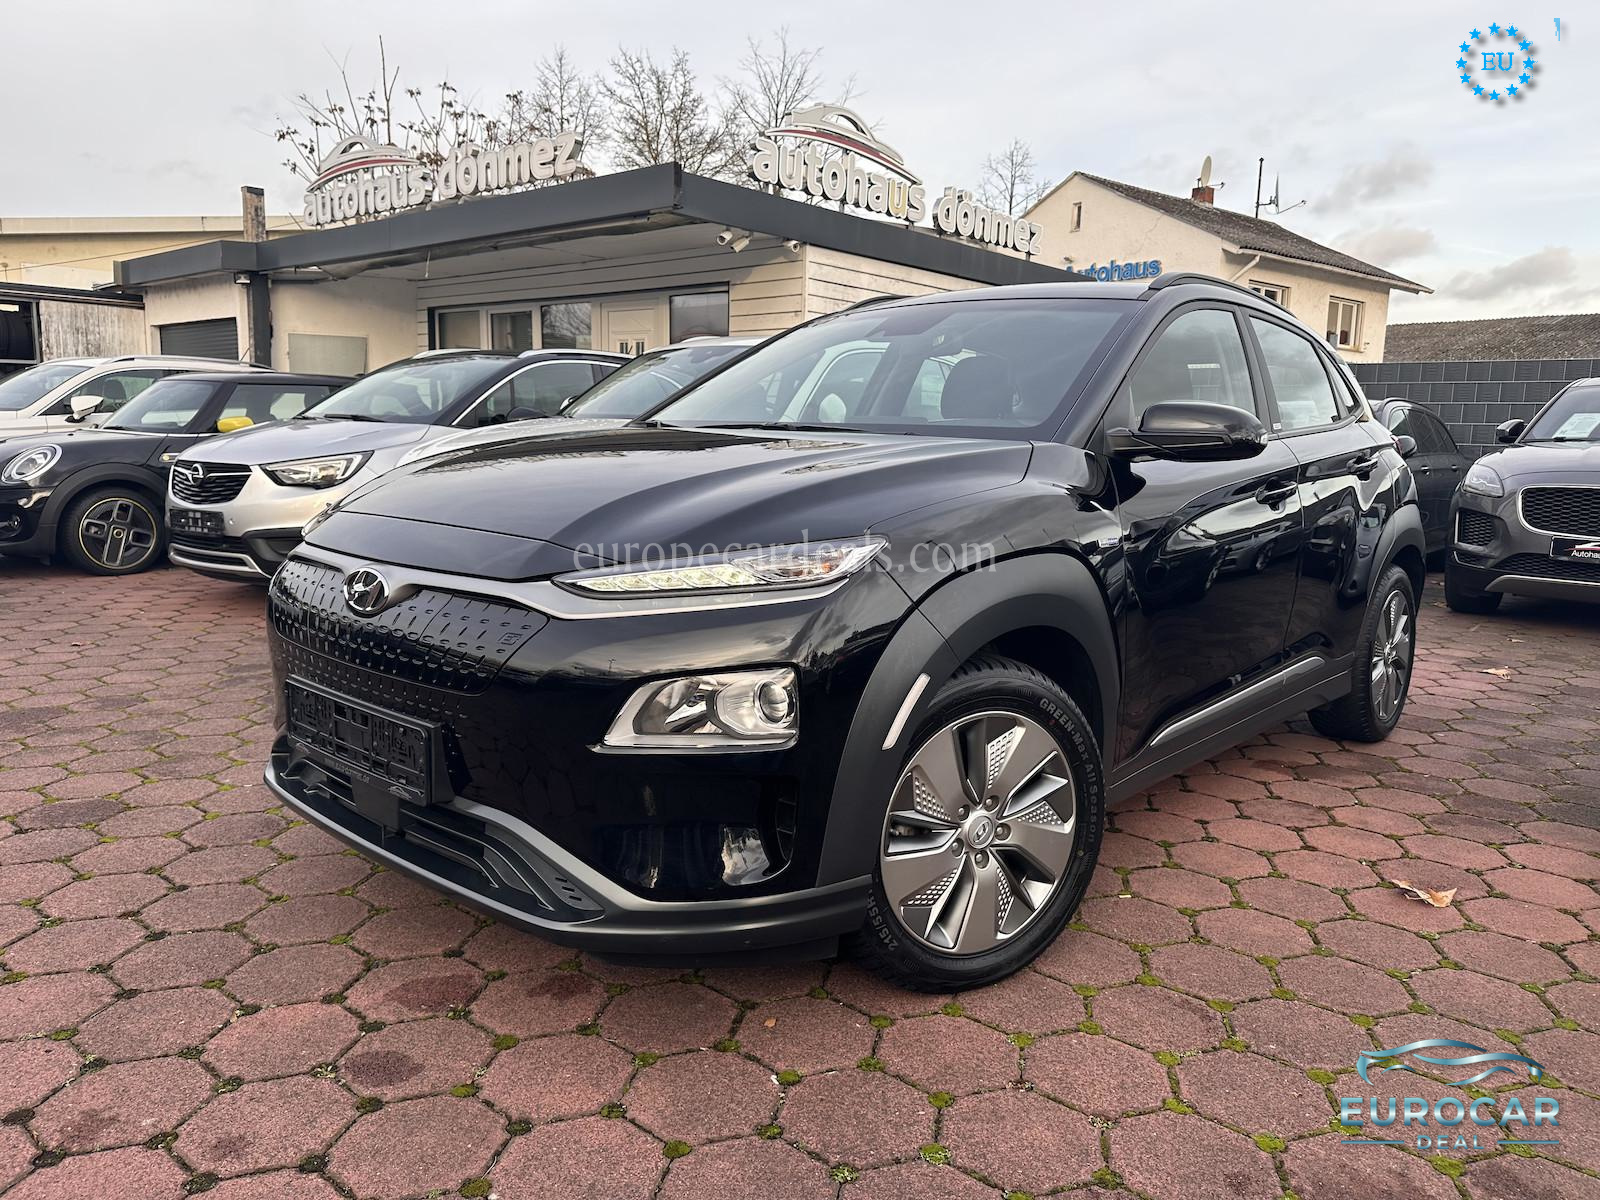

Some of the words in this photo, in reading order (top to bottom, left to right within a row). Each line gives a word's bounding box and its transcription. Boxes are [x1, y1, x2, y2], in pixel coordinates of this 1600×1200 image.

[303, 167, 428, 226] autohaus
[436, 131, 583, 198] dönmez
[752, 136, 926, 223] autohaus
[935, 186, 1043, 255] dönmez
[866, 888, 898, 951] 215/55R
